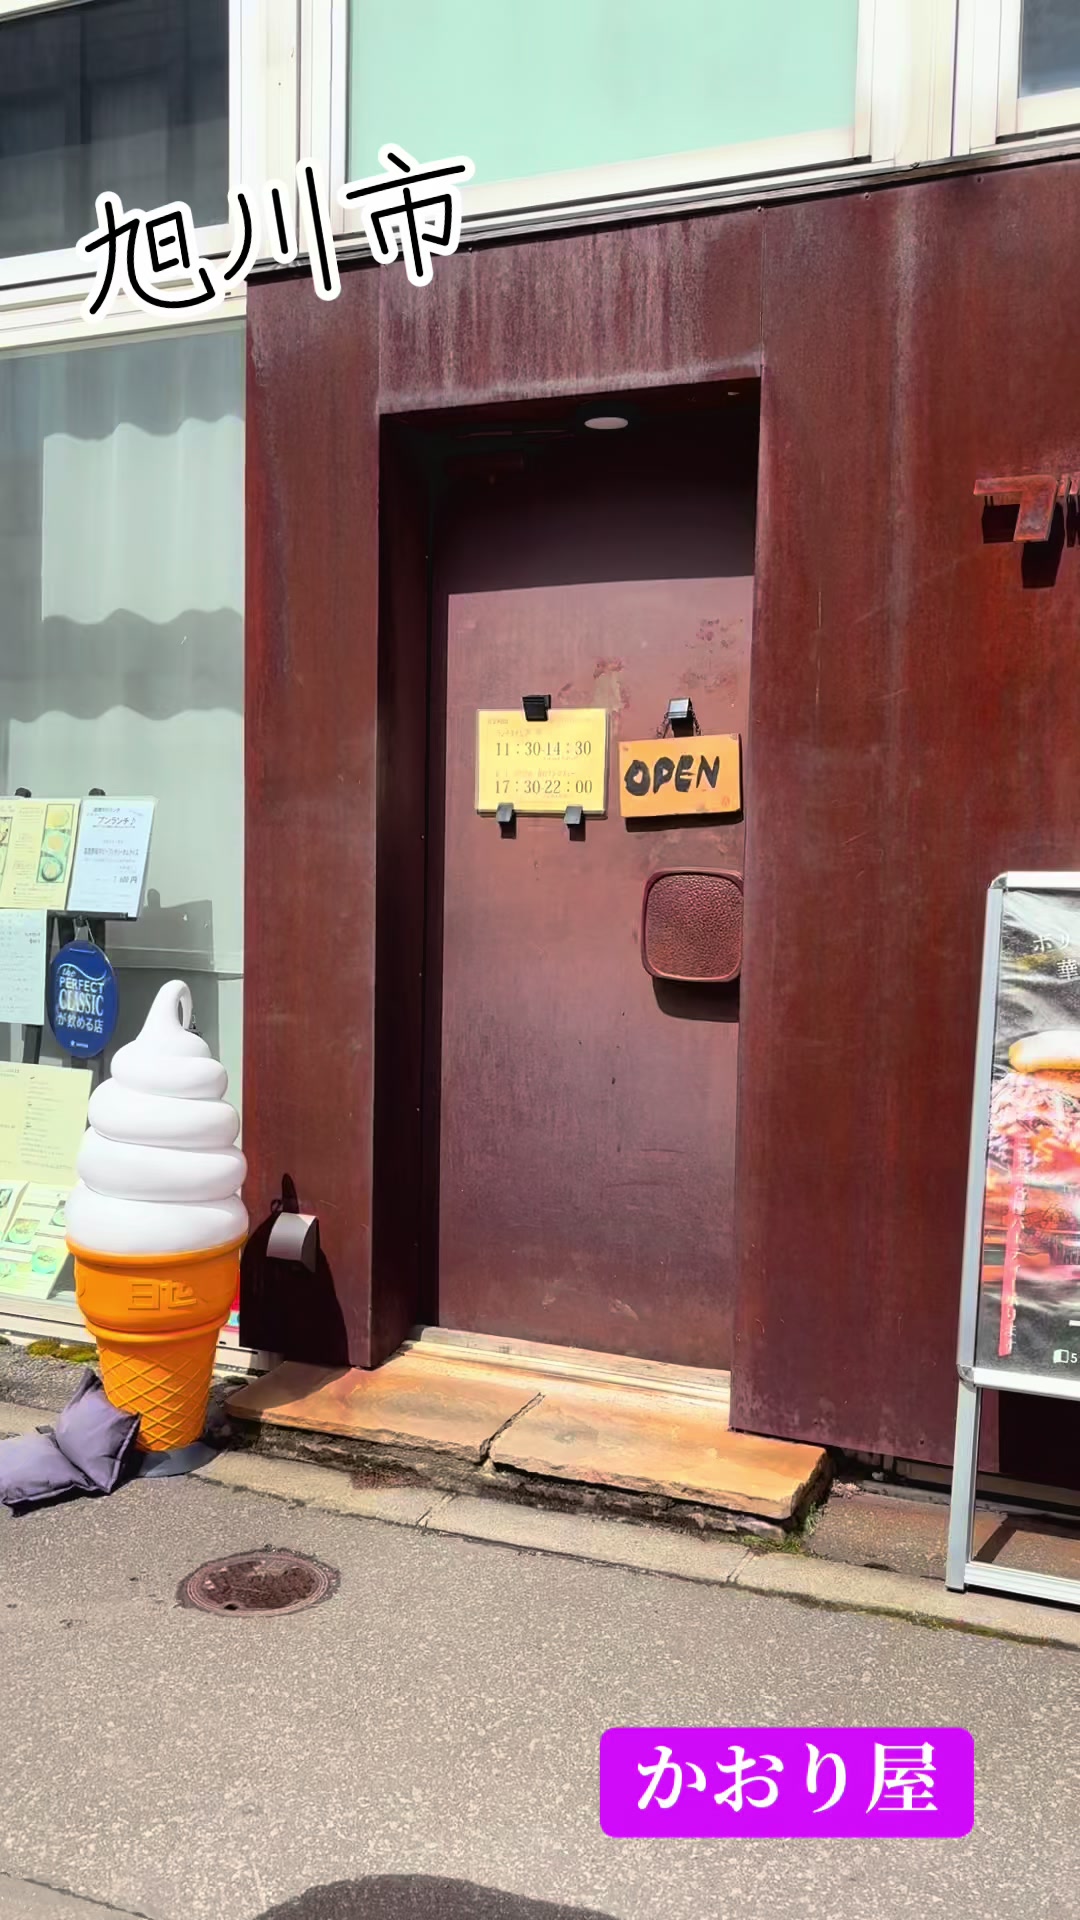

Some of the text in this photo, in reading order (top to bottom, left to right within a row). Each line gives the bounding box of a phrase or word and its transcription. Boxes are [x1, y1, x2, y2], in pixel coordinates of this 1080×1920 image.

[624, 754, 720, 797] OPEN
[59, 975, 104, 994] PERFECT
[58, 988, 104, 1017] CLASSIC
[57, 1011, 104, 1034] が飲める店
